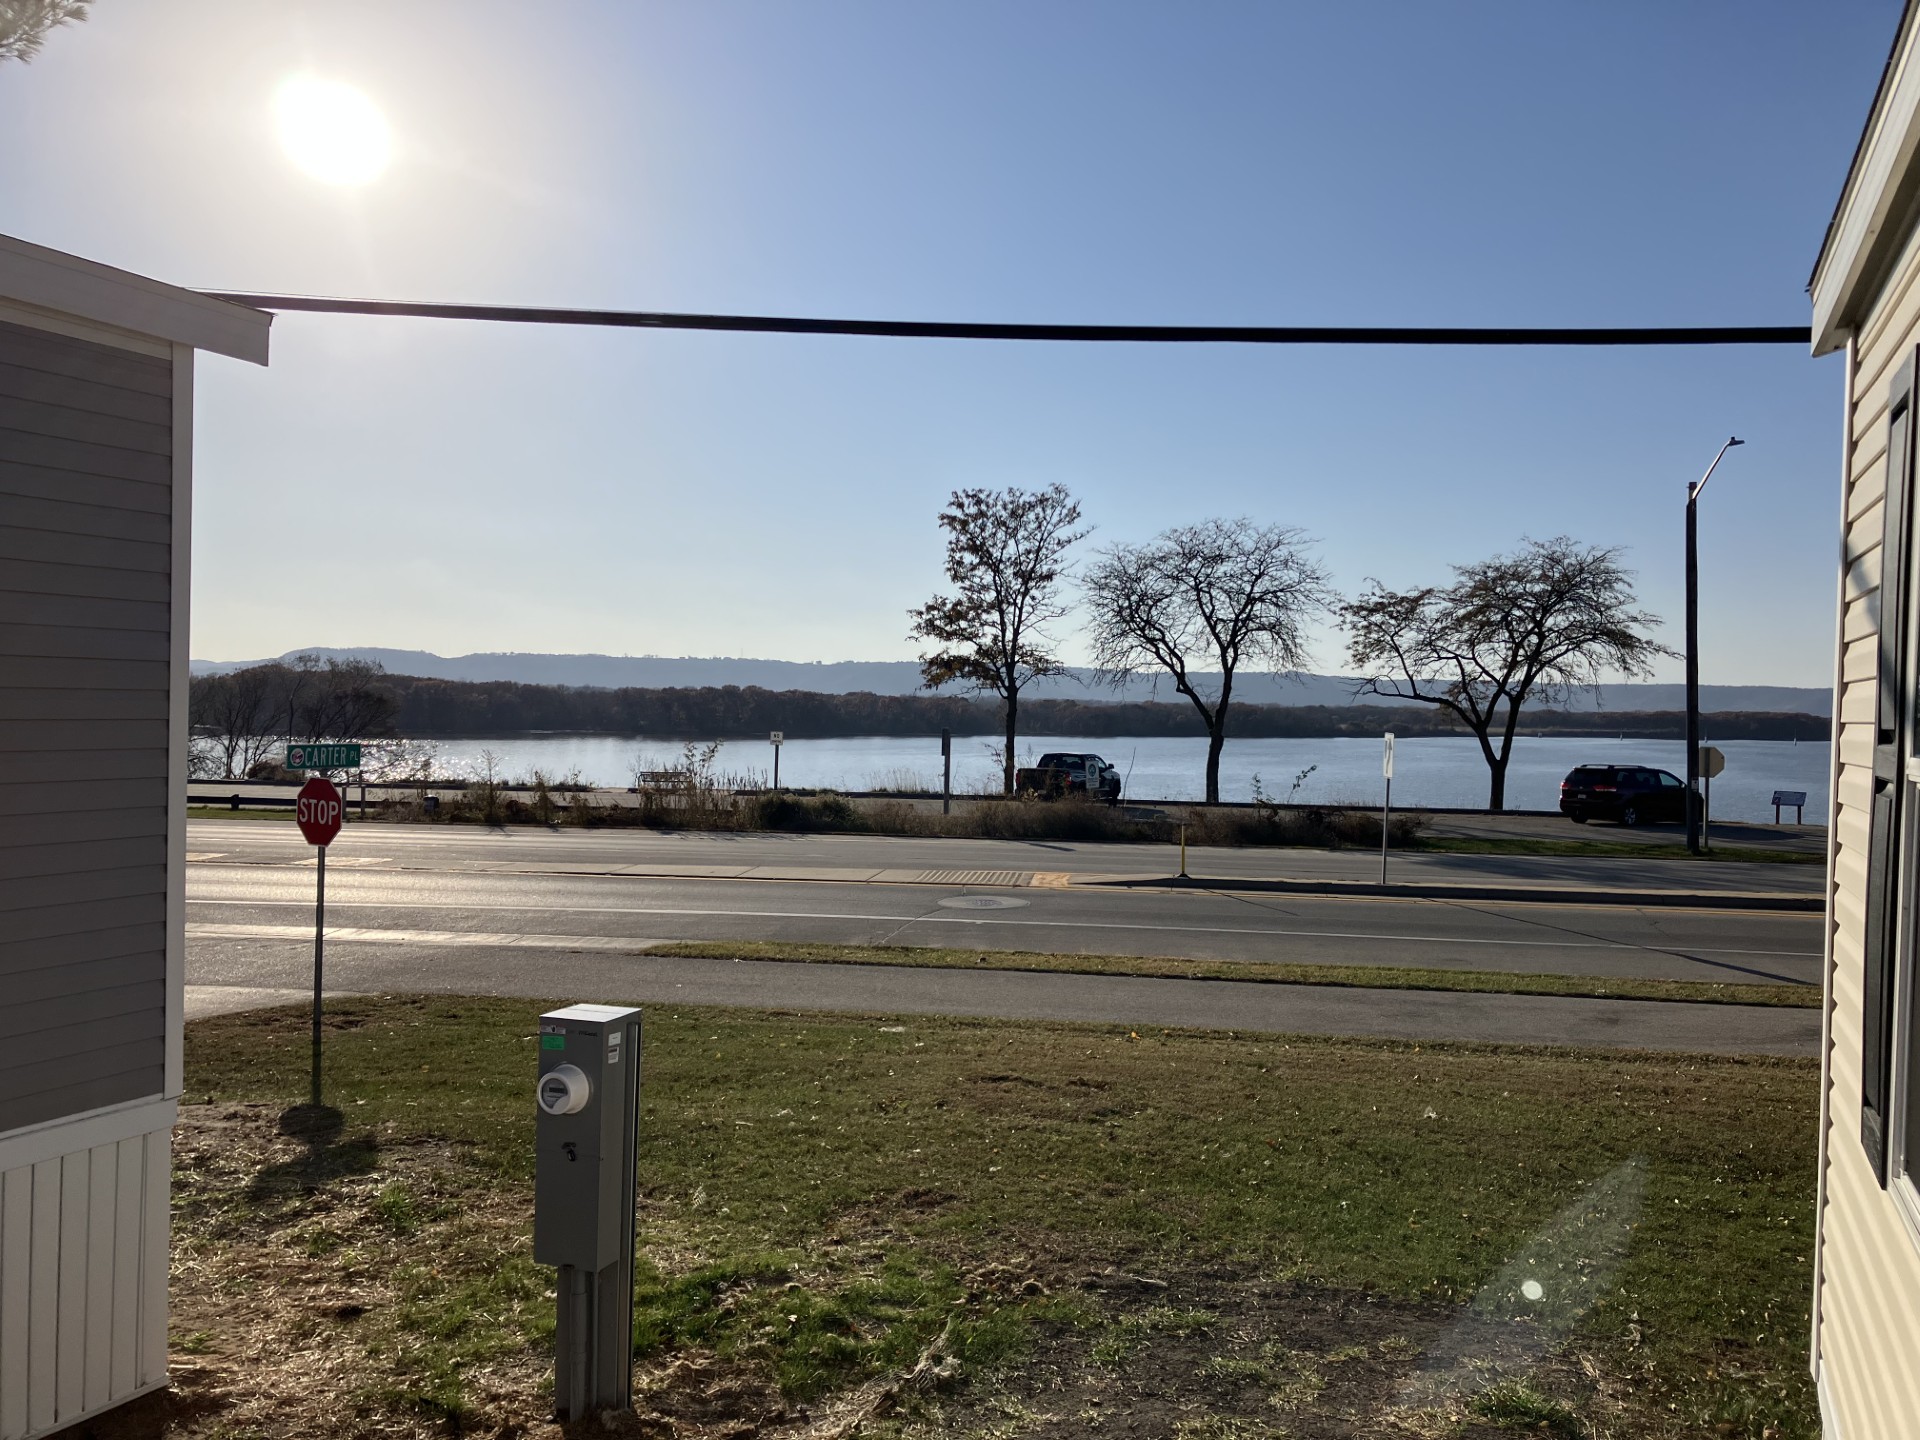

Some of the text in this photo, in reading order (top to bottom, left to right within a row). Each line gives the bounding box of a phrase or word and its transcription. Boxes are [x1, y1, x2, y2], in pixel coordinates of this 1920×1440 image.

[305, 746, 358, 766] CARTER PL
[299, 798, 339, 825] STOP
